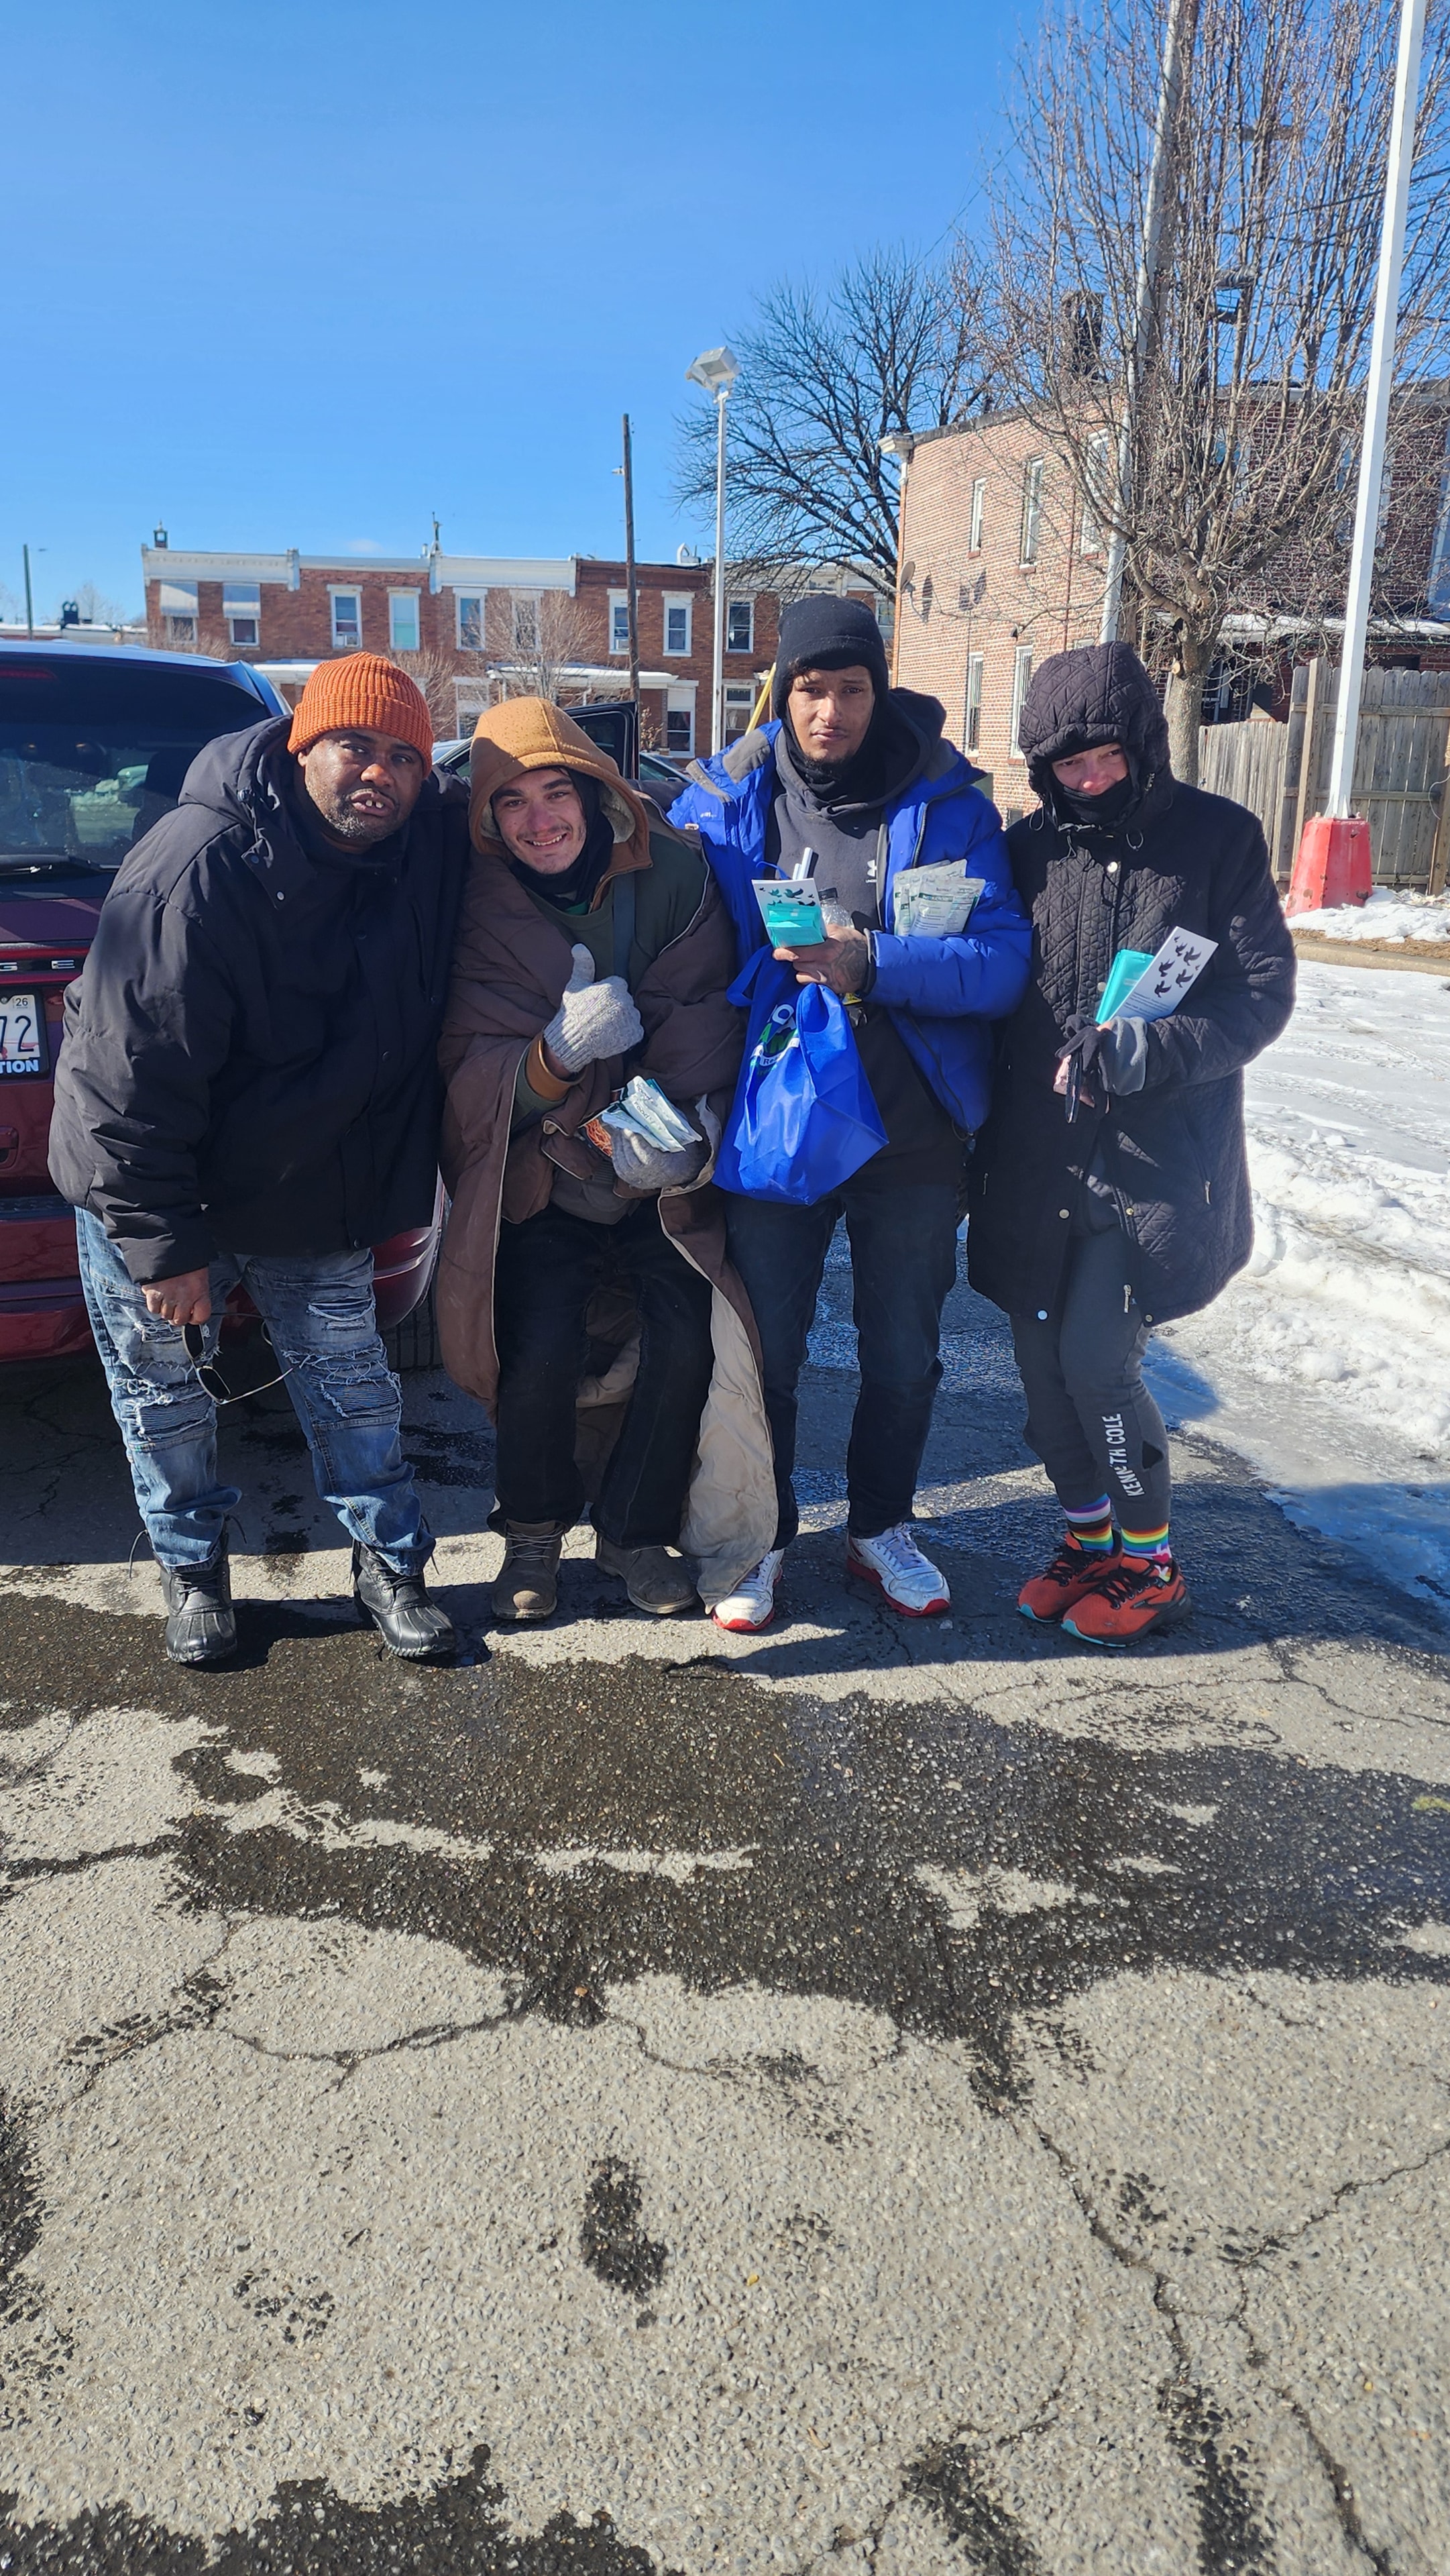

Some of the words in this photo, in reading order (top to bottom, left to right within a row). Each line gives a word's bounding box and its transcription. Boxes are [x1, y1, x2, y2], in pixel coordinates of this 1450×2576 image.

[15, 998, 28, 1007] 26
[0, 1059, 39, 1073] TION
[1101, 1413, 1126, 1444] COLE
